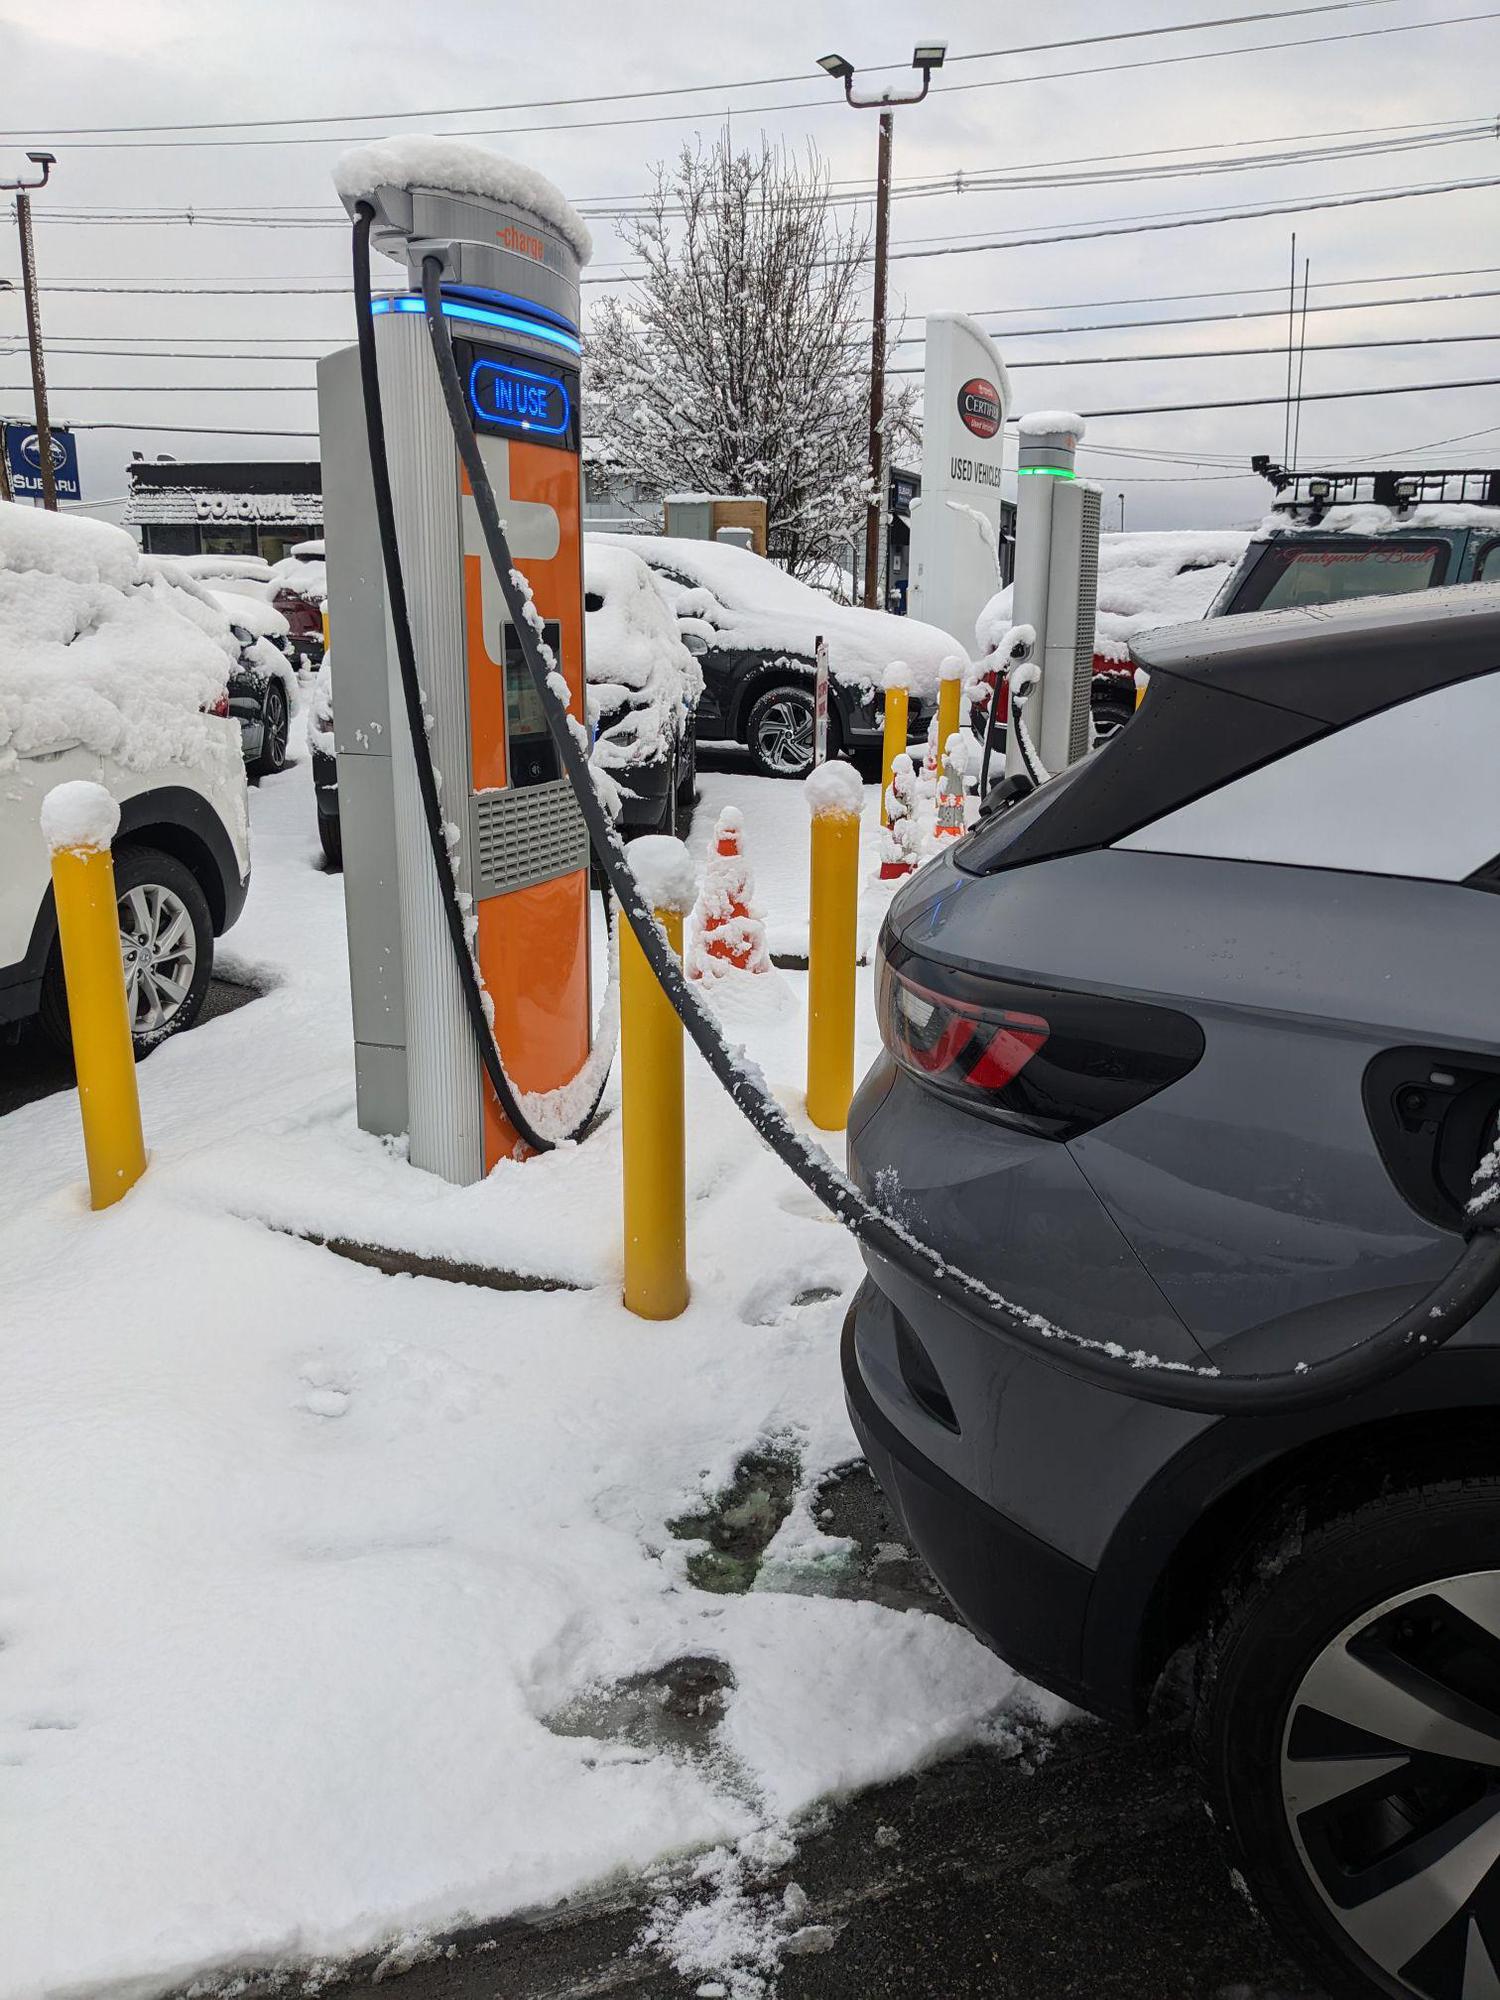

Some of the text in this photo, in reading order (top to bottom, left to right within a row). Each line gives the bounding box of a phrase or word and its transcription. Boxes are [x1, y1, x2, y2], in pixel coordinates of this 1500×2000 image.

[495, 378, 547, 419] IN USE
[950, 456, 1001, 489] USED VEHICLES
